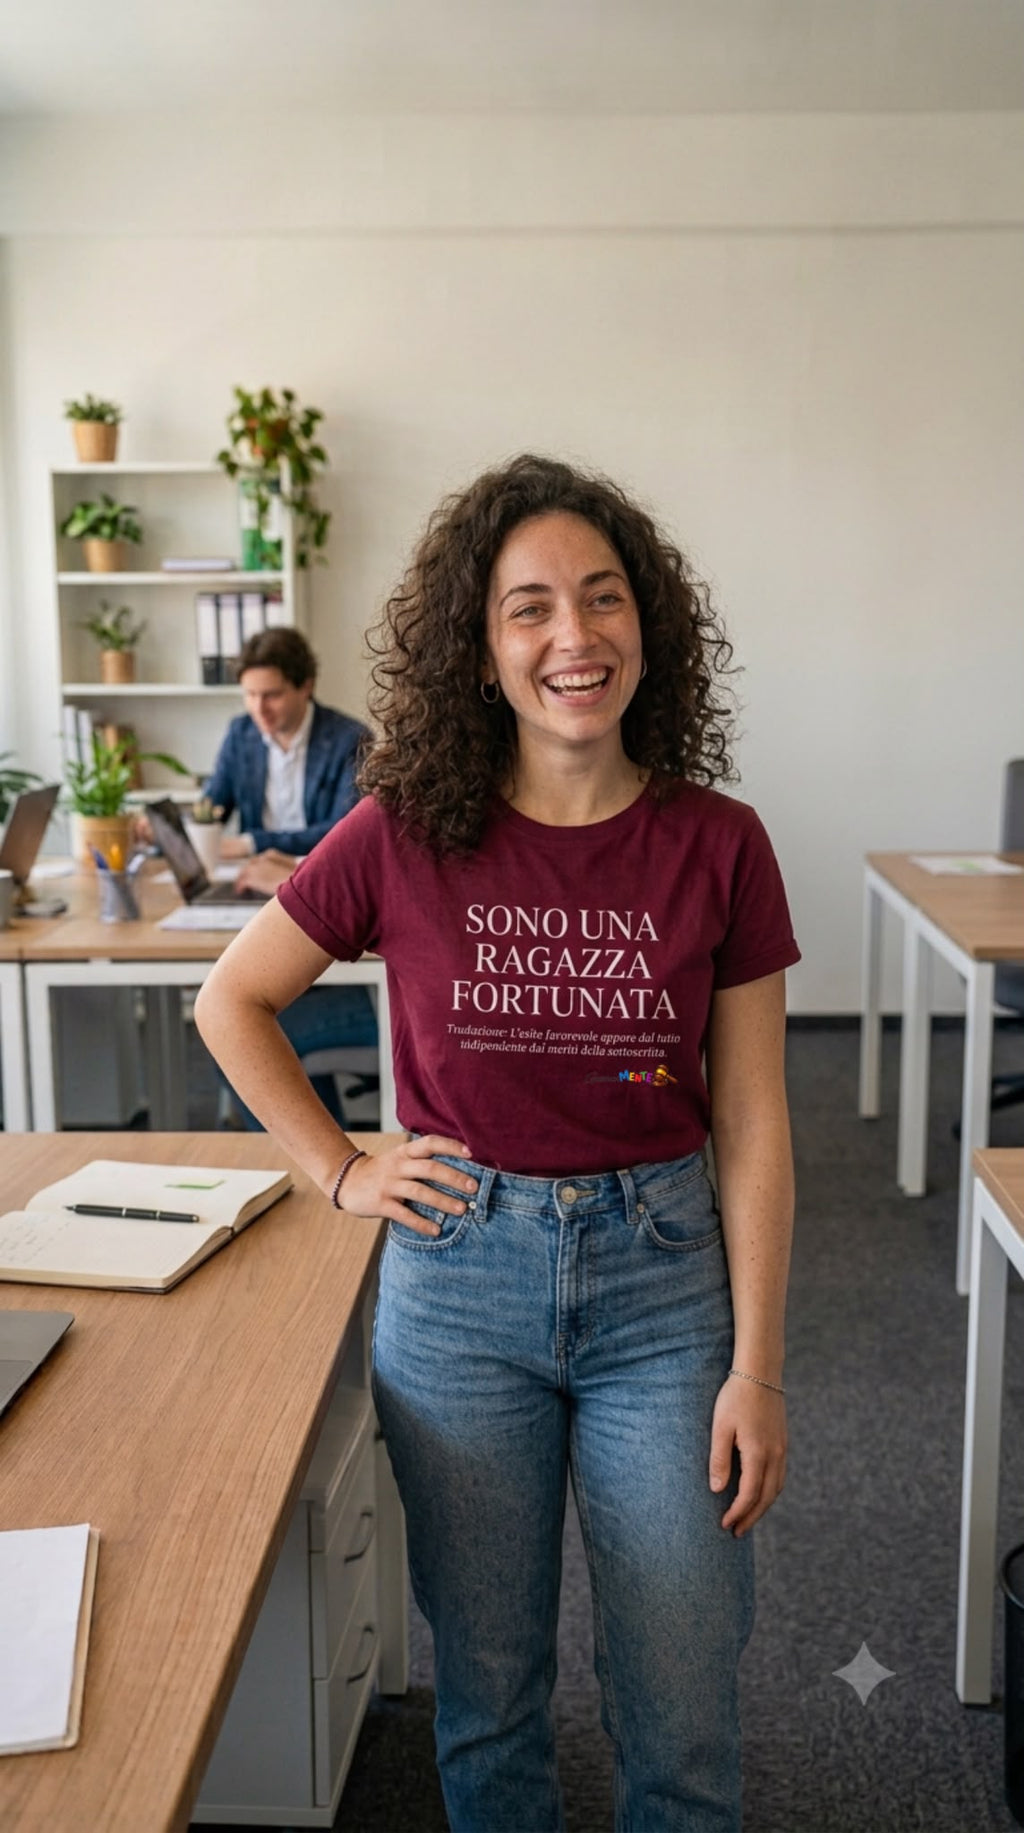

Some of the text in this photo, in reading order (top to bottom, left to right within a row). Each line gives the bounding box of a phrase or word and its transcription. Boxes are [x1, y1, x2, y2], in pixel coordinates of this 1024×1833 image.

[466, 904, 660, 942] SONO UNA
[474, 943, 653, 979] RAGAZZA
[451, 980, 678, 1020] FORTUNATA
[528, 1042, 546, 1054] dai
